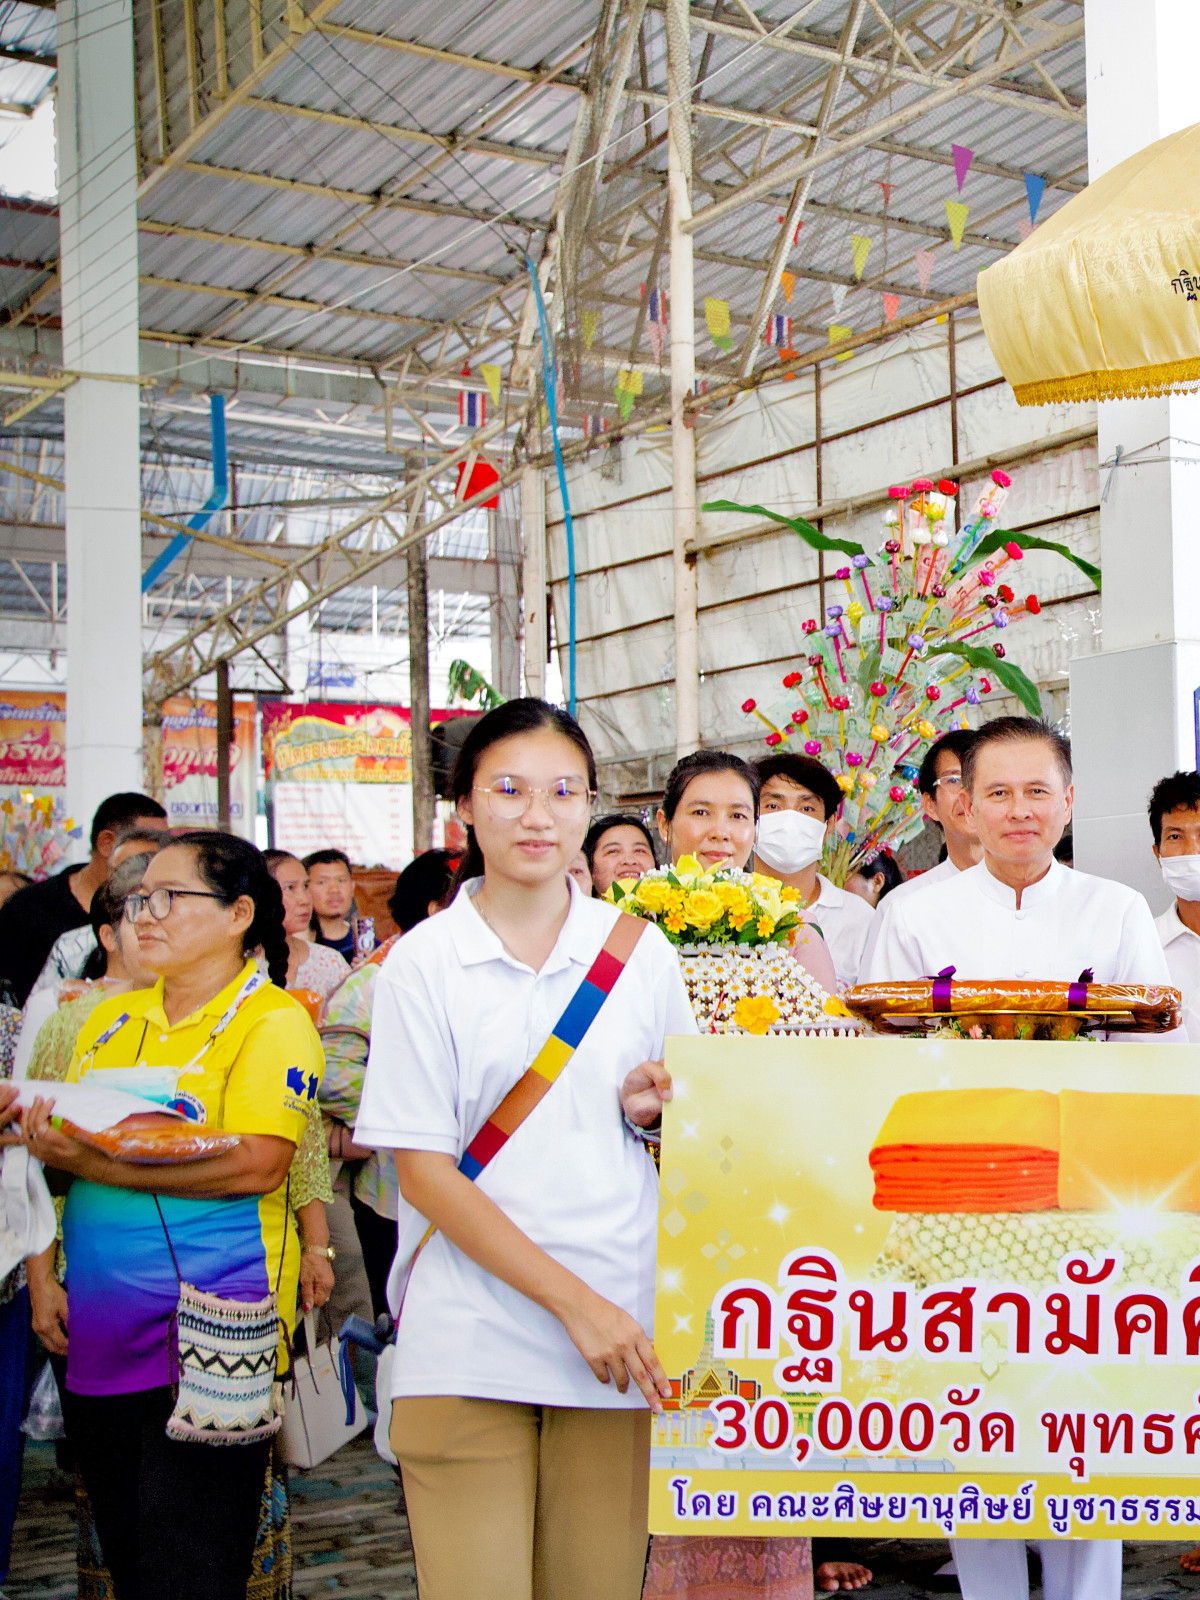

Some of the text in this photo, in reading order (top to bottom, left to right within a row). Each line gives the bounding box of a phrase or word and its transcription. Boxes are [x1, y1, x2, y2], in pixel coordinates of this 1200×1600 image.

[672, 1479, 737, 1519] โดย
[752, 1483, 1036, 1533] คณะศิษยานุศิษย์
